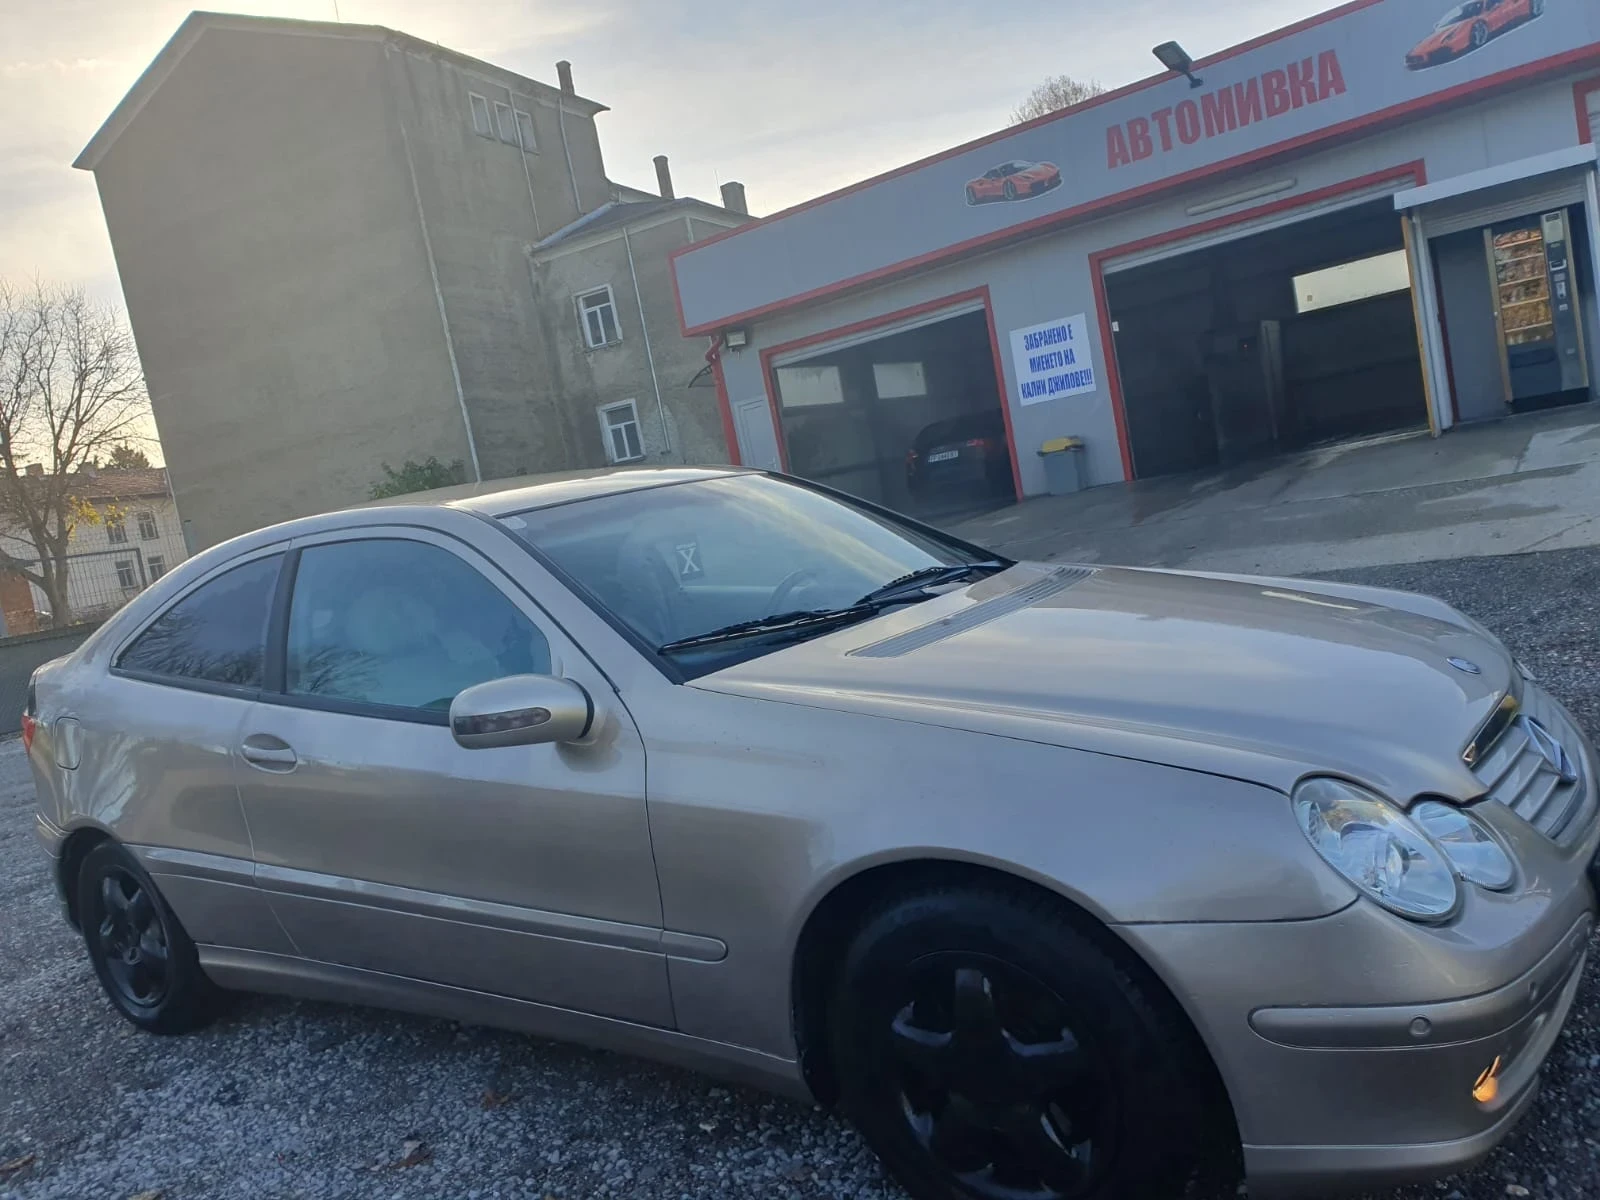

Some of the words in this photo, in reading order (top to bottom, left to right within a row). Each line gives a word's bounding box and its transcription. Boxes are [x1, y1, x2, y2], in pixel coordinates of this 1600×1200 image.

[1106, 50, 1347, 170] АВТОМИВКА
[1023, 325, 1067, 351] ЗАБРАНЕНО
[1029, 351, 1063, 373] МИЕНЕТО
[1063, 348, 1076, 366] НА
[1021, 379, 1047, 399] КАЛНИ
[1047, 368, 1093, 396] ДЖИПОВЕ!!!
